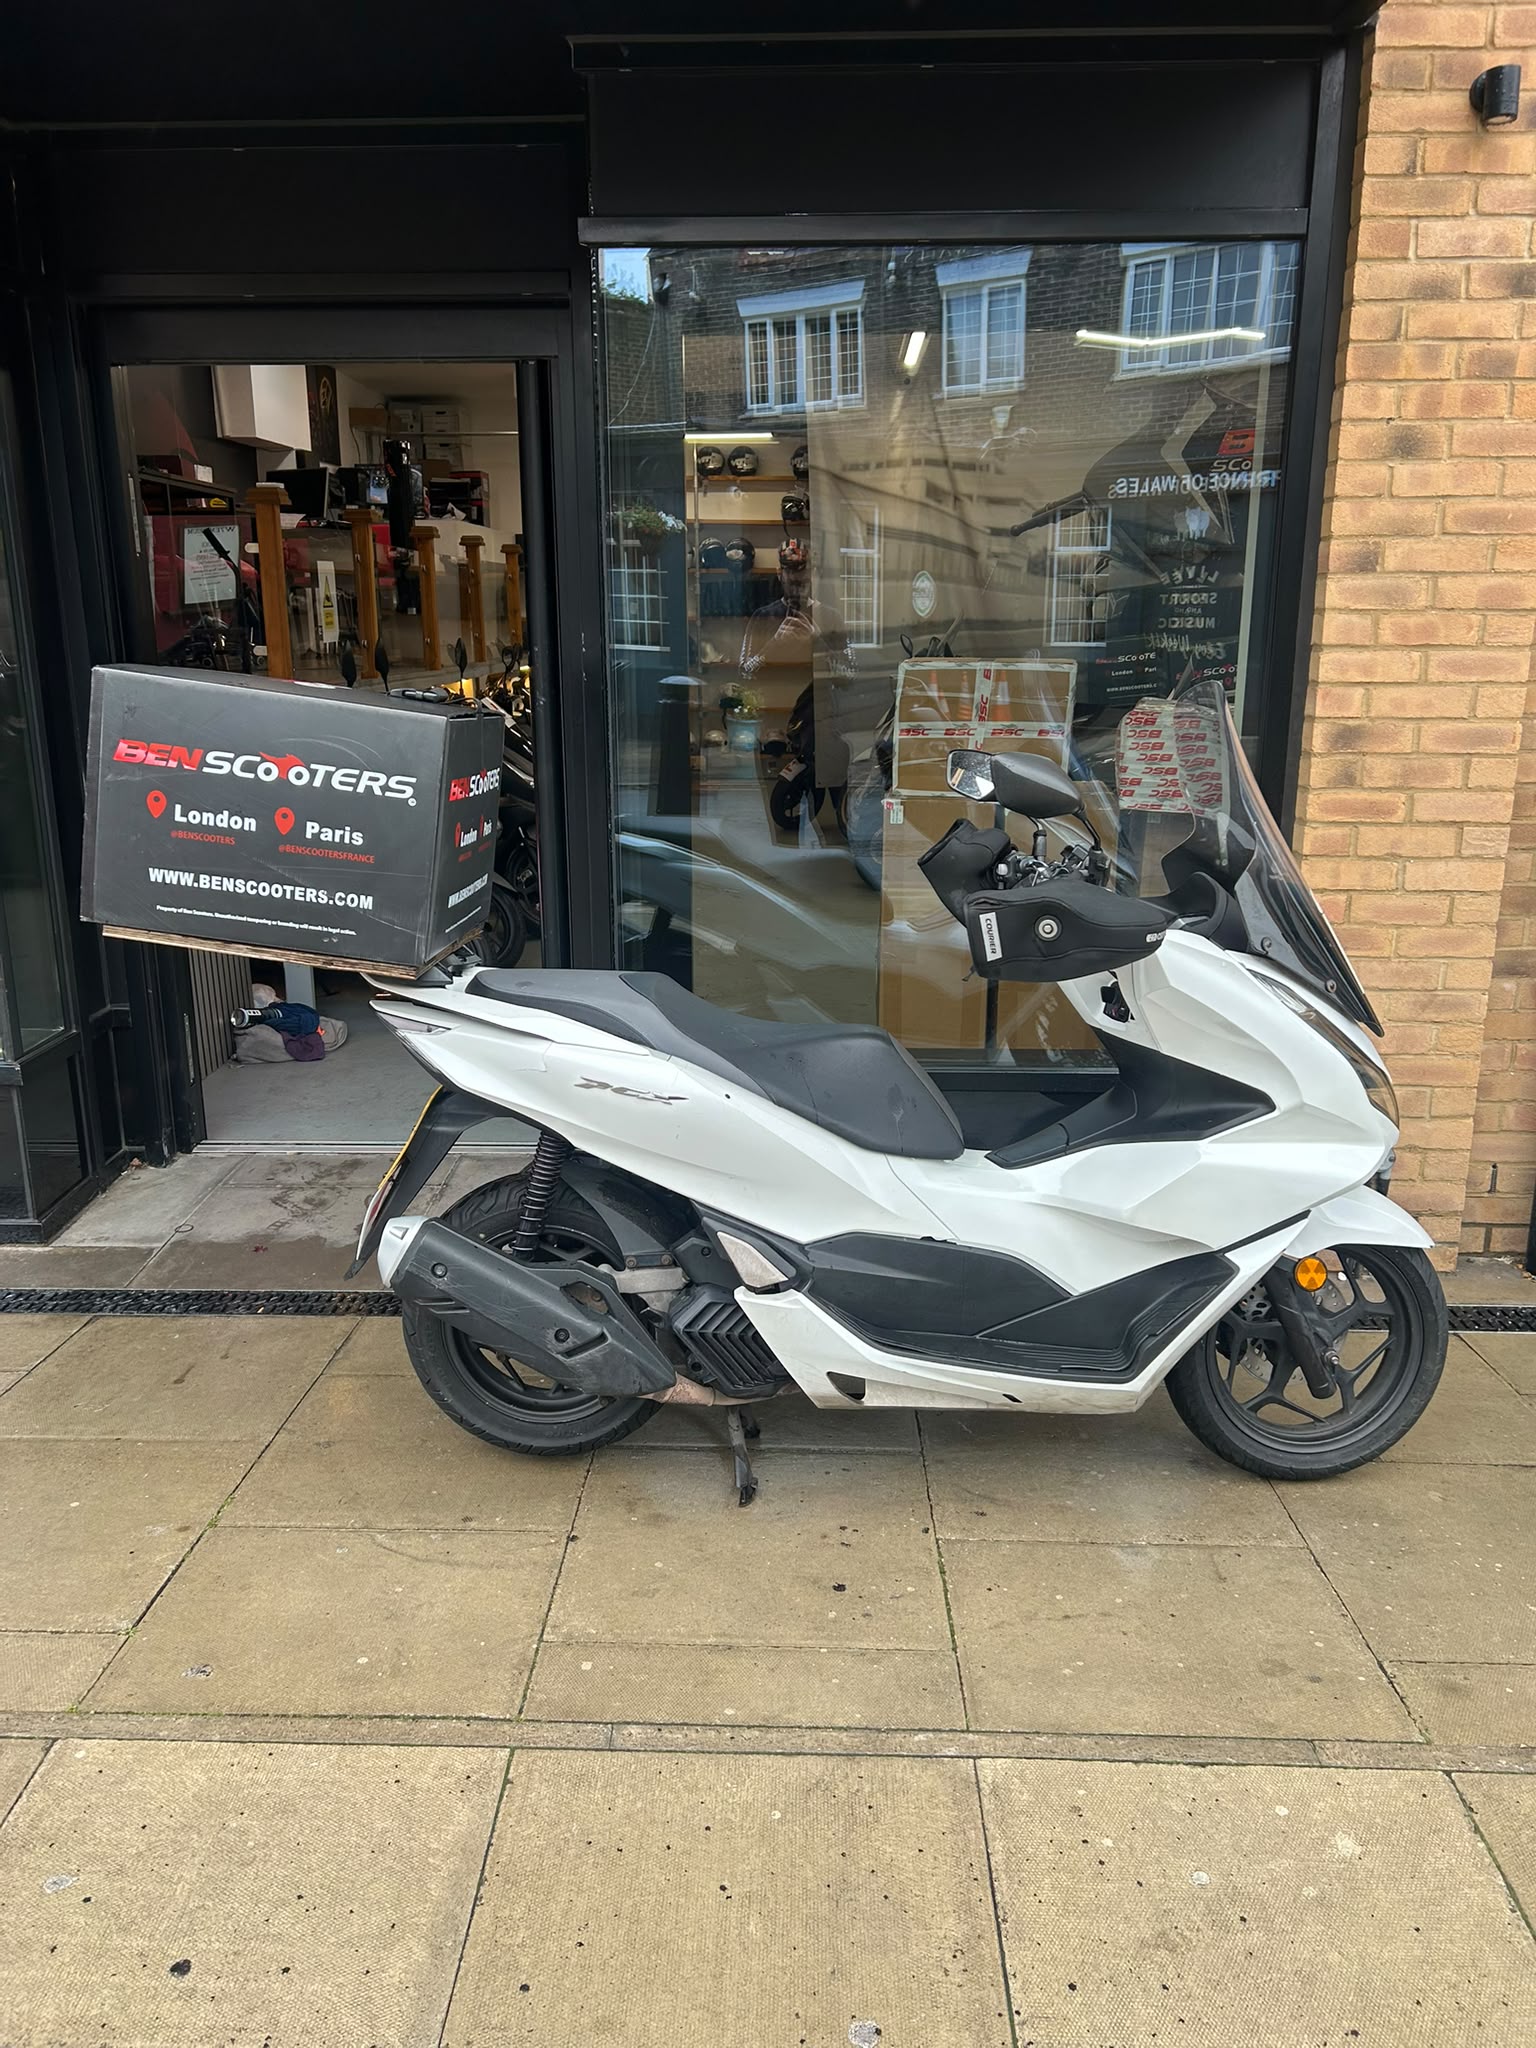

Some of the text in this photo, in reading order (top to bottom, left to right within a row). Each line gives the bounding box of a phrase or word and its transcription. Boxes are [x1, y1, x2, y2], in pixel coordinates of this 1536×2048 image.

[1127, 730, 1162, 738] BSC
[1128, 742, 1165, 750] BSC
[1136, 754, 1173, 762] BSC
[1142, 767, 1178, 775] BSC
[174, 804, 364, 846] London Paris
[170, 830, 375, 864] @BENSCOOTERS @BENSCOOTERSFRANCE
[460, 827, 478, 847] London
[149, 867, 373, 910] WWW.BENSCOOTERS.COM
[985, 918, 996, 954] COURIER
